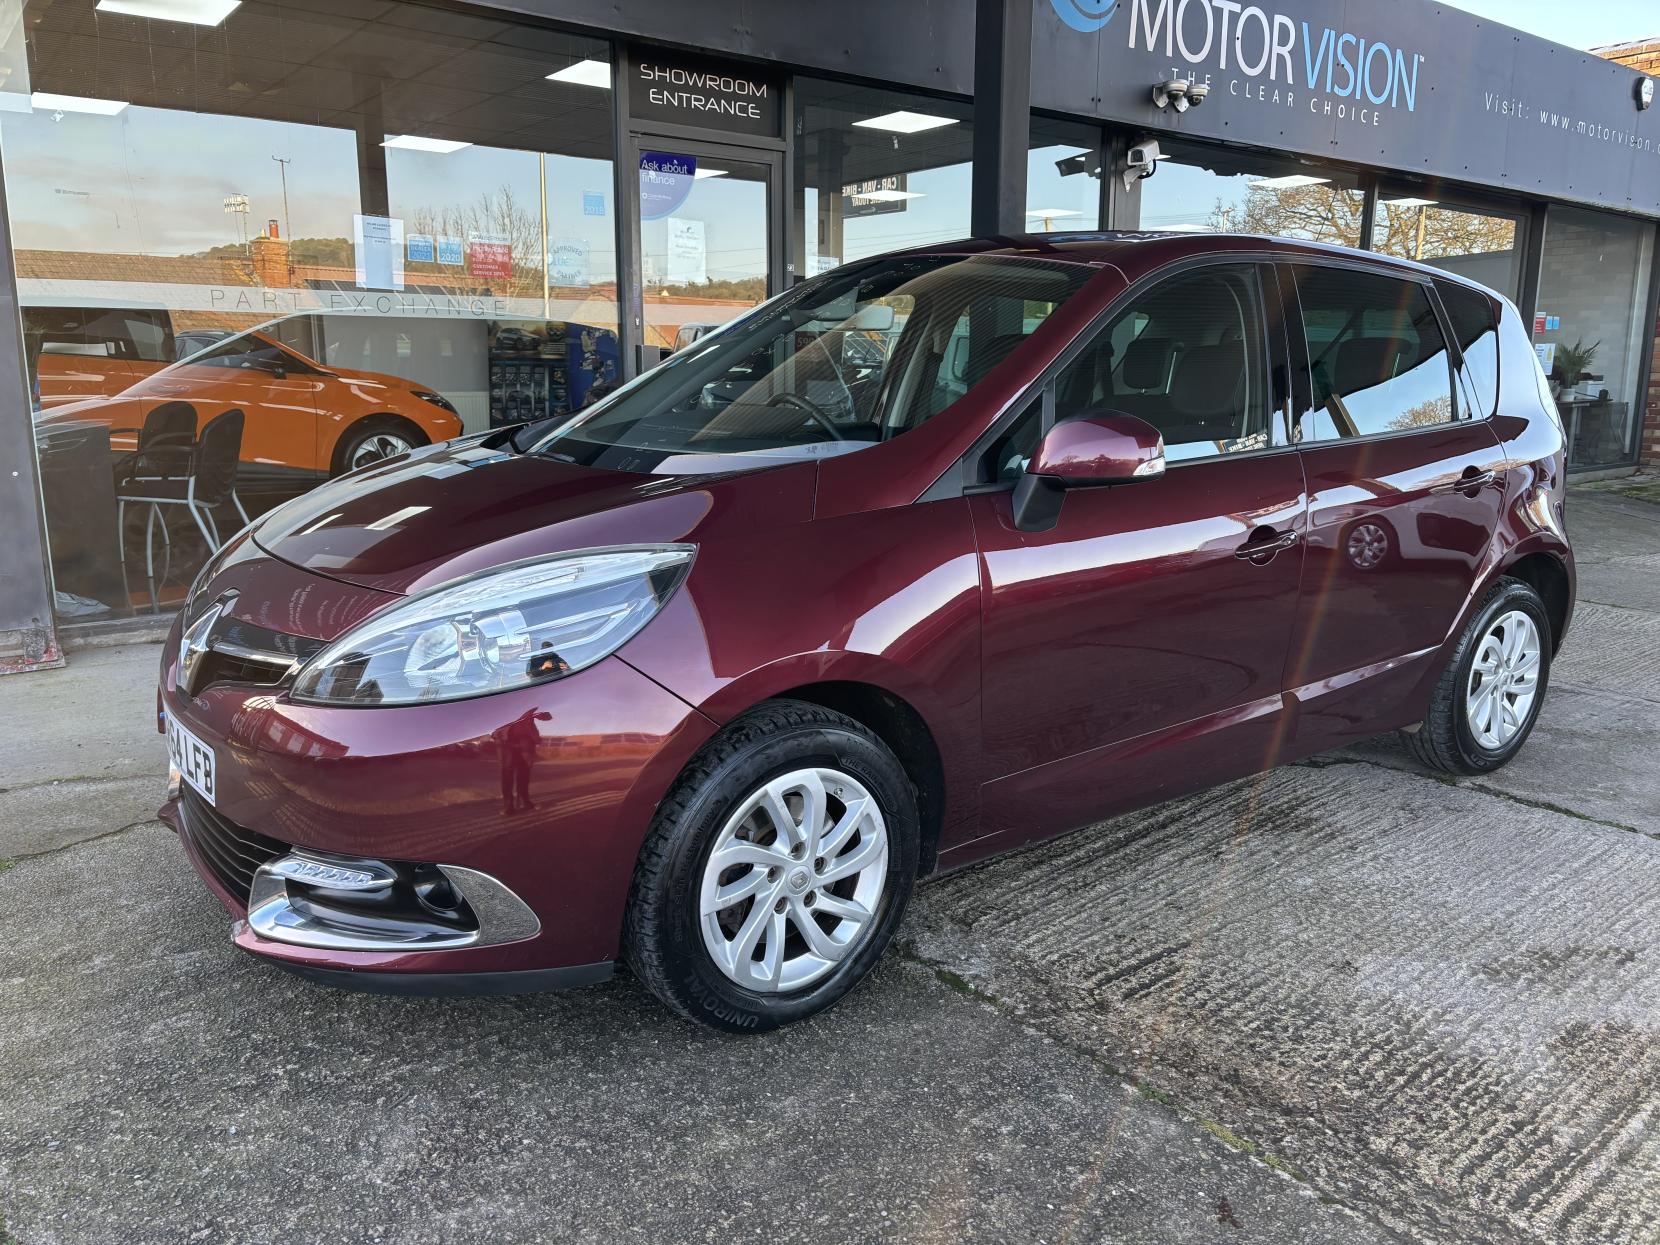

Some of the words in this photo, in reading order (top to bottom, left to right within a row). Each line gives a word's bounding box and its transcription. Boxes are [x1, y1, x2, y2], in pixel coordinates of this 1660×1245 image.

[640, 63, 767, 98] SHOWROOM
[649, 88, 761, 119] ENTRANCE
[1172, 67, 1211, 89] THE
[1230, 80, 1294, 107] CLEAR
[1310, 98, 1380, 126] CHOICE
[1485, 91, 1530, 119] Visit:
[641, 160, 659, 171] Ask
[662, 163, 688, 175] about
[642, 172, 675, 186] finance
[441, 253, 461, 262] 2020
[210, 289, 301, 310] PART
[331, 294, 505, 317] EXCHANGE
[184, 734, 213, 796] LFB
